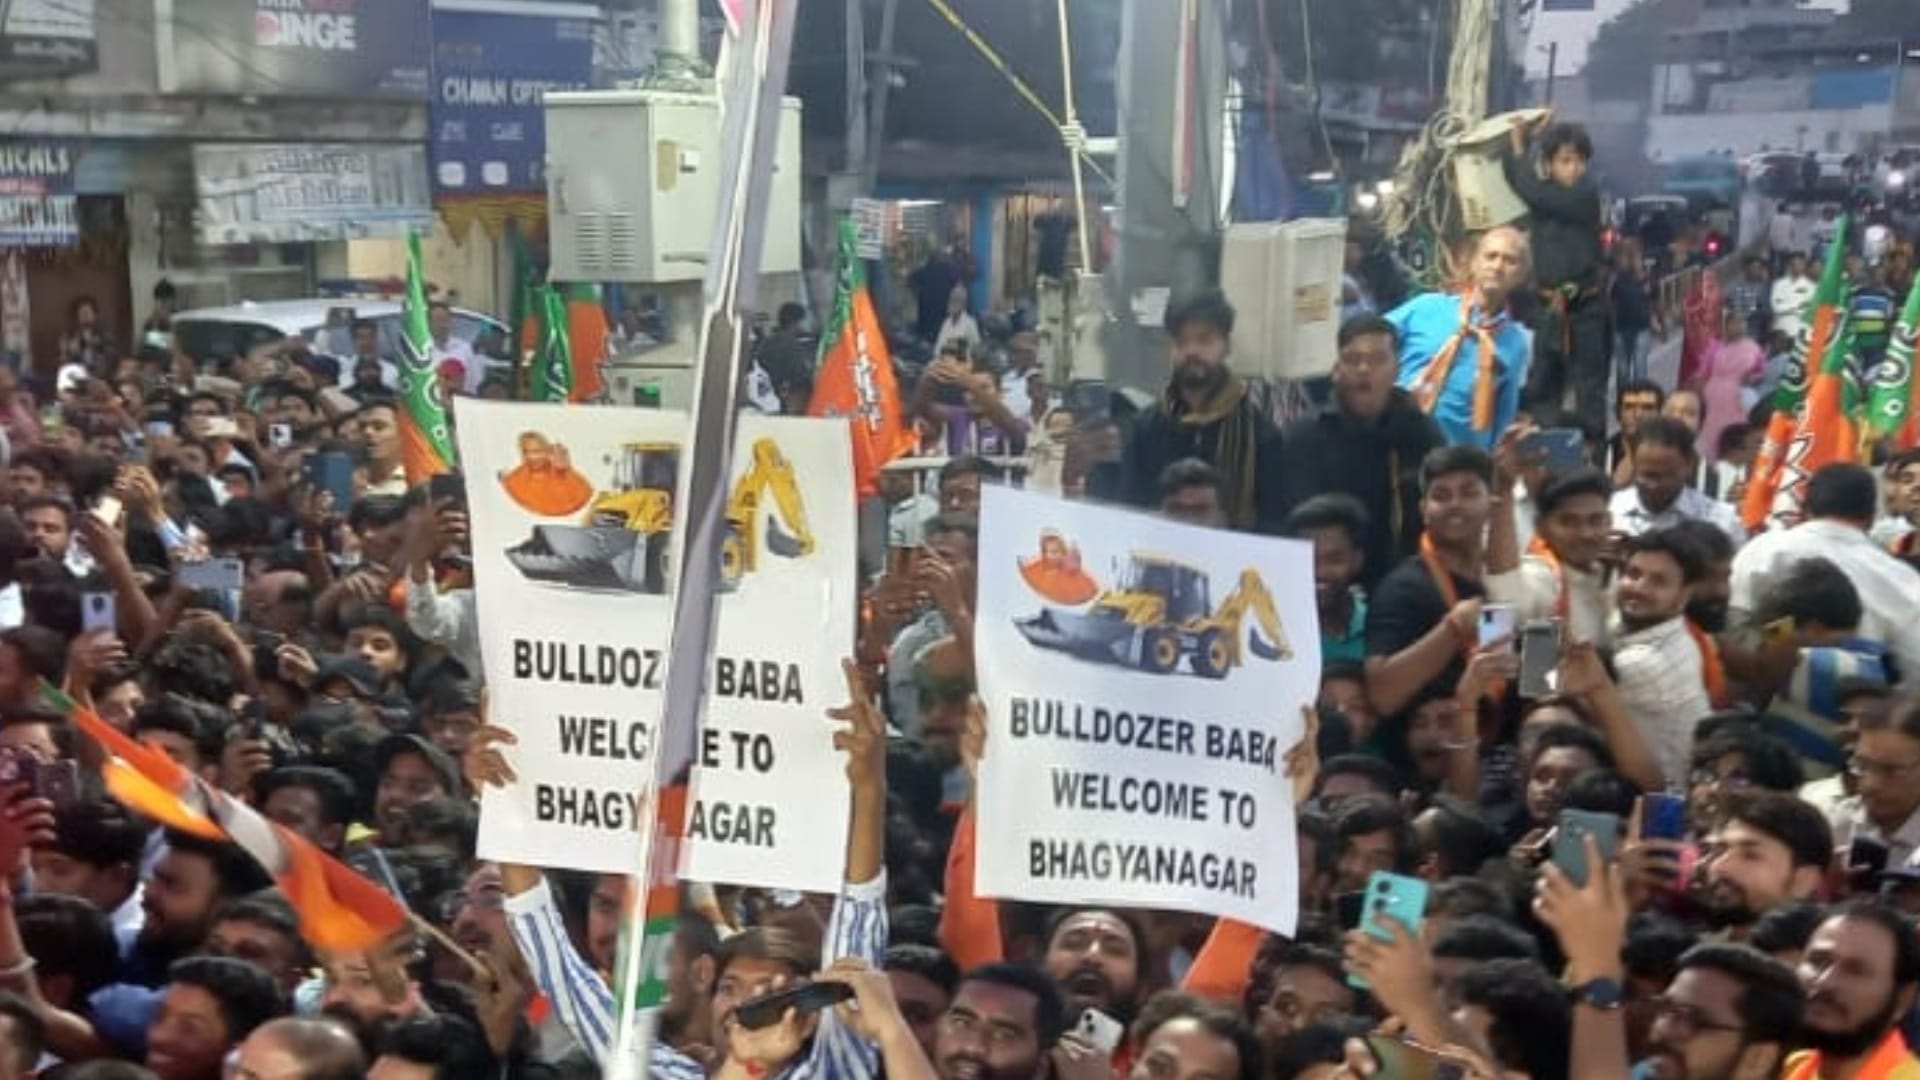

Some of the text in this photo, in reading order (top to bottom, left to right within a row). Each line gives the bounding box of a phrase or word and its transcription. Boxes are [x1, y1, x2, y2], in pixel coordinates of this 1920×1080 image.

[513, 639, 803, 703] BULLDOZ BABA
[558, 715, 776, 773] WELCE TO
[1010, 698, 1278, 774] BULLDOZER BABA
[536, 784, 776, 848] BHAGYAGAR
[1050, 767, 1257, 830] WELCOME TO
[1029, 838, 1257, 900] BHAGYANAGAR
